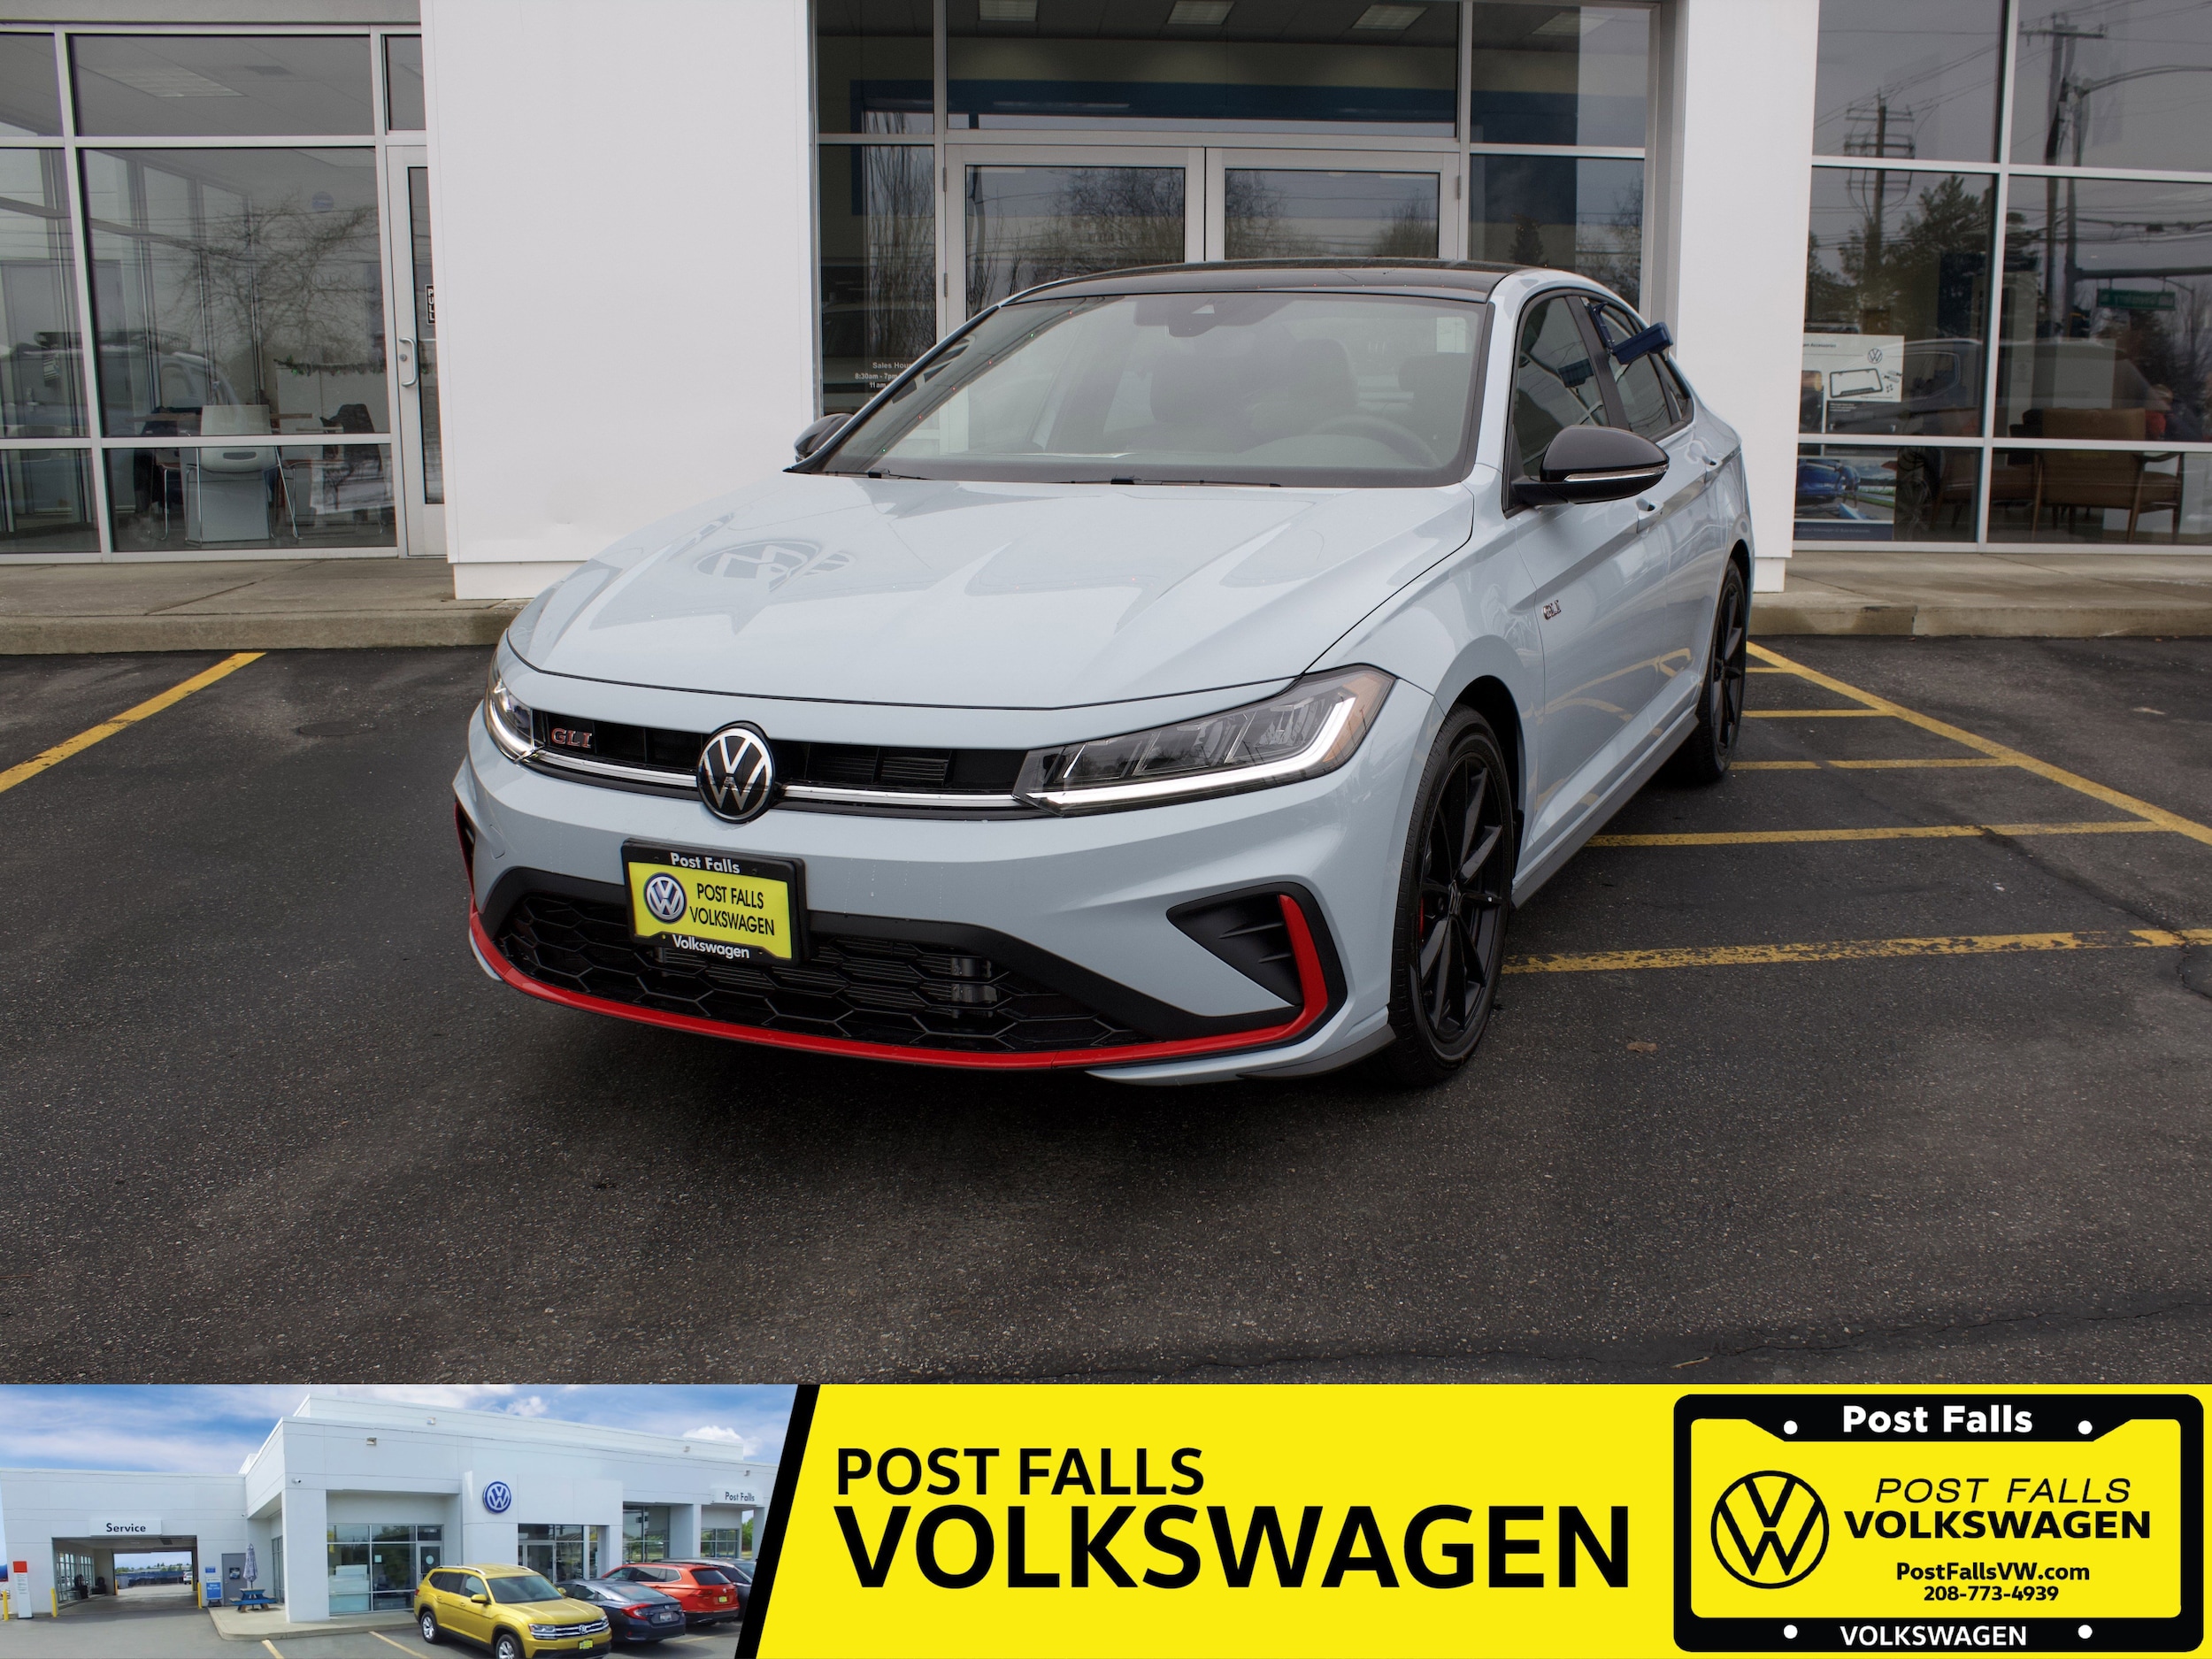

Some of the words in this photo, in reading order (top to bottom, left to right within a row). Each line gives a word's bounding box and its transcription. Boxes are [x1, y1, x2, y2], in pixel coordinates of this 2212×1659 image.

[550, 727, 592, 749] GLI
[670, 852, 701, 869] Post
[704, 856, 741, 874] Falls
[696, 883, 726, 902] POST
[731, 887, 764, 909] FALLS
[689, 906, 775, 935] VOLKSWAGEN
[672, 933, 750, 959] Volkswagen
[725, 1491, 739, 1502] Post
[740, 1492, 756, 1502] Falls
[105, 1522, 146, 1534] Service
